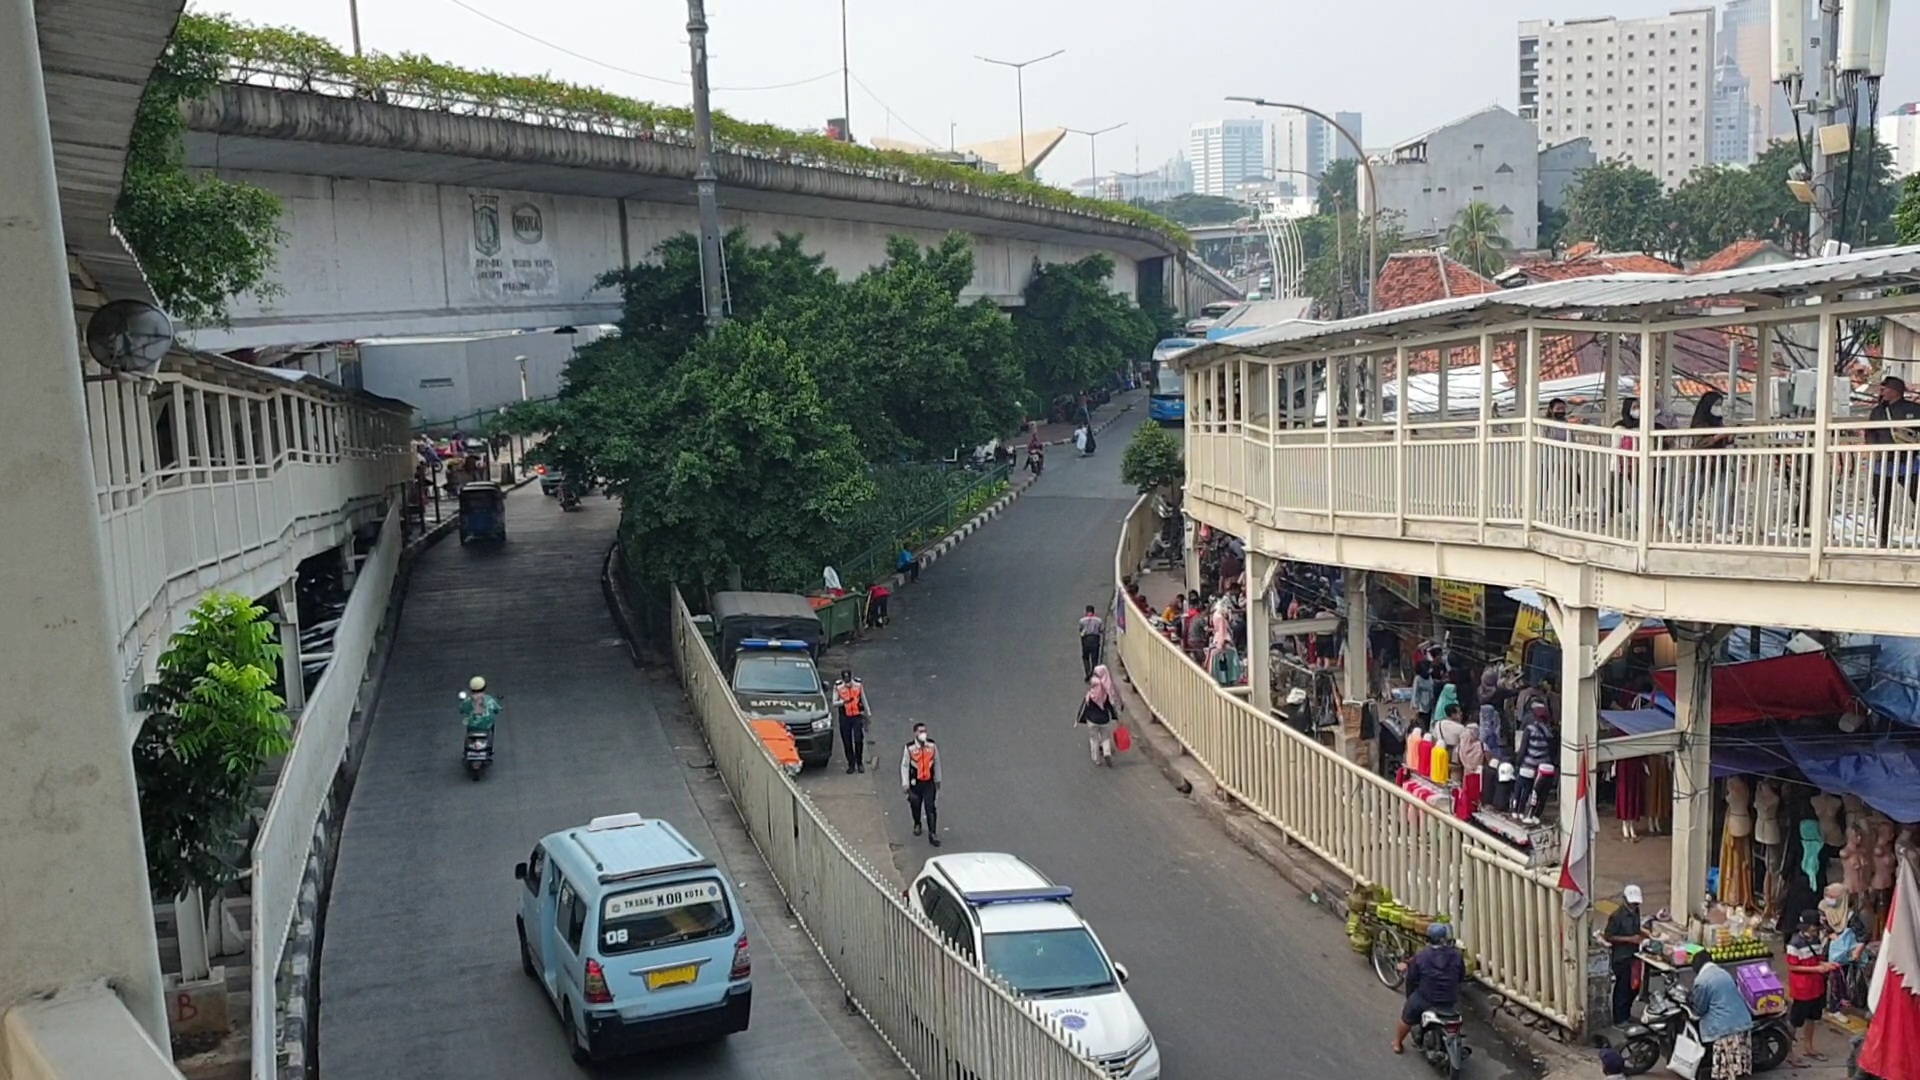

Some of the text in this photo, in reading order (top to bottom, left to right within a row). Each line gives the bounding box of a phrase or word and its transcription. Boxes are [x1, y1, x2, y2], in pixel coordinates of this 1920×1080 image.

[750, 700, 812, 709] SATPOL PP
[684, 889, 704, 899] KOTA
[177, 994, 198, 1022] B
